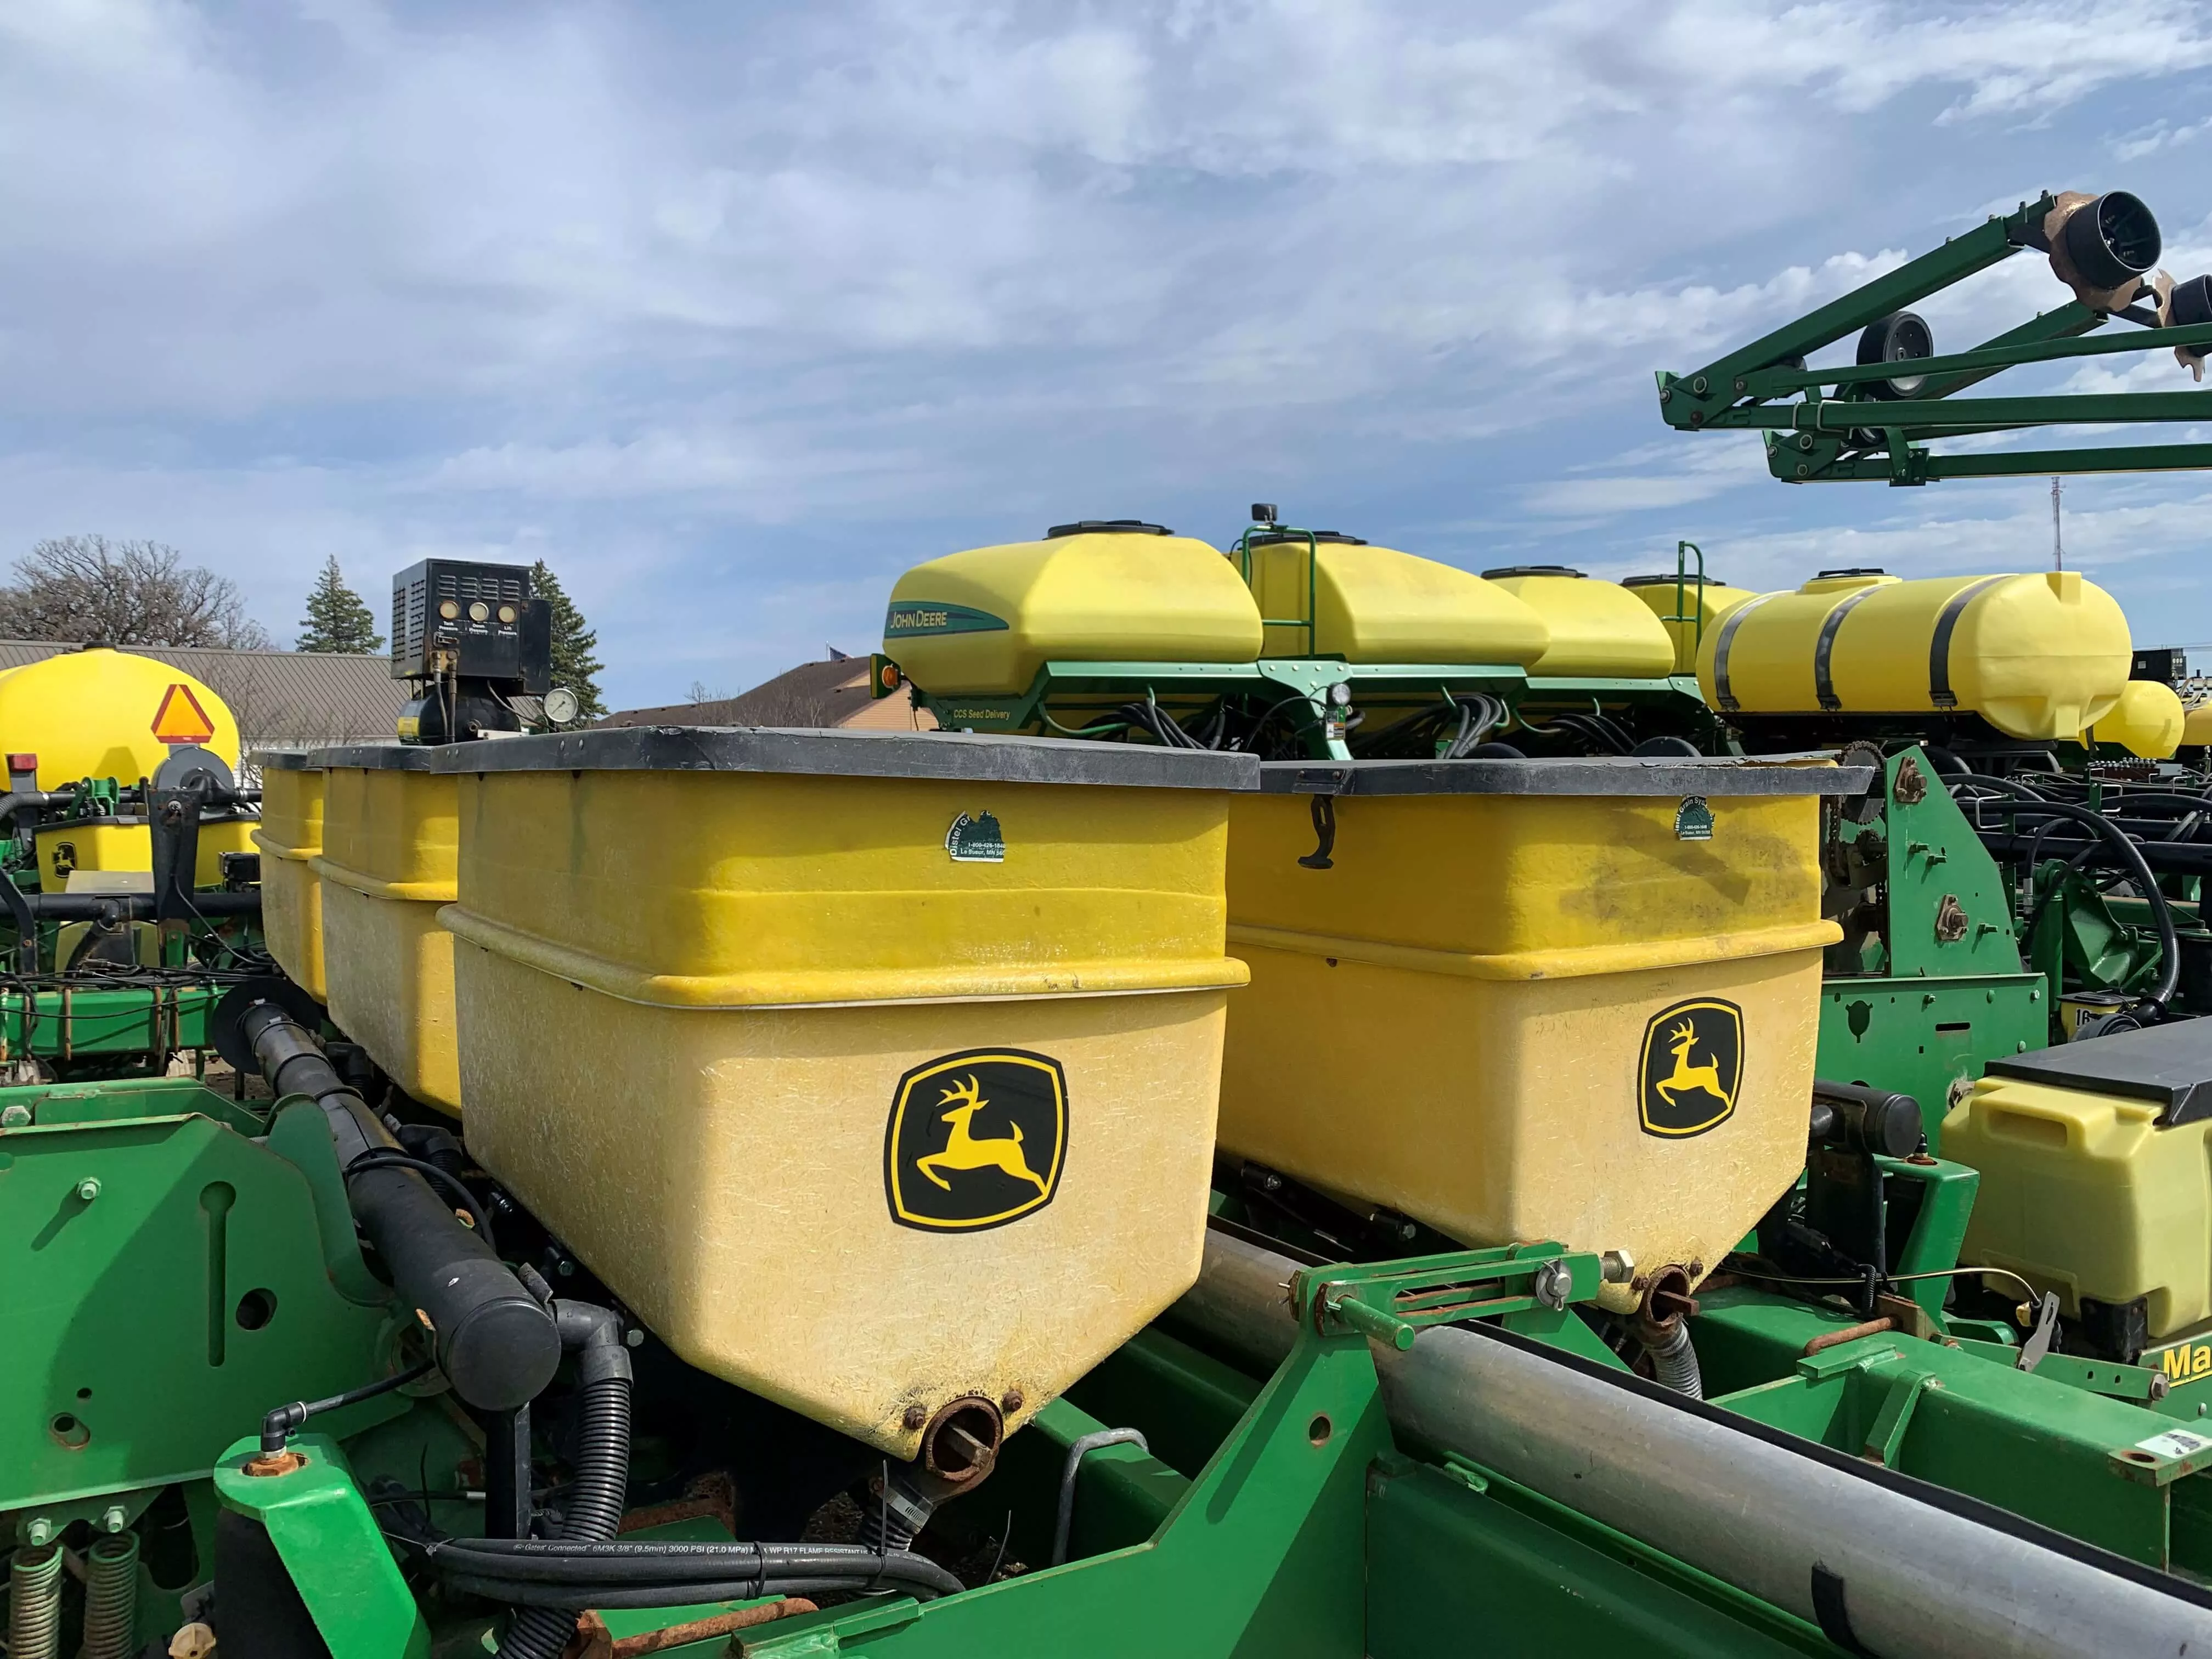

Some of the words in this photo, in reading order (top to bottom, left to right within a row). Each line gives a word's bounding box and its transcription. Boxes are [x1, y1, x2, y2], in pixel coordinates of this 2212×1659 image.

[890, 612, 915, 629] JOHN
[916, 610, 947, 627] DEERE
[954, 709, 967, 718] CCS
[968, 709, 984, 719] Seed
[985, 709, 1011, 721] Delivery
[950, 827, 962, 856] Distel
[634, 1545, 666, 1554] (9.5mm)
[707, 1546, 726, 1554] (21.0
[728, 1546, 748, 1555] MPa)
